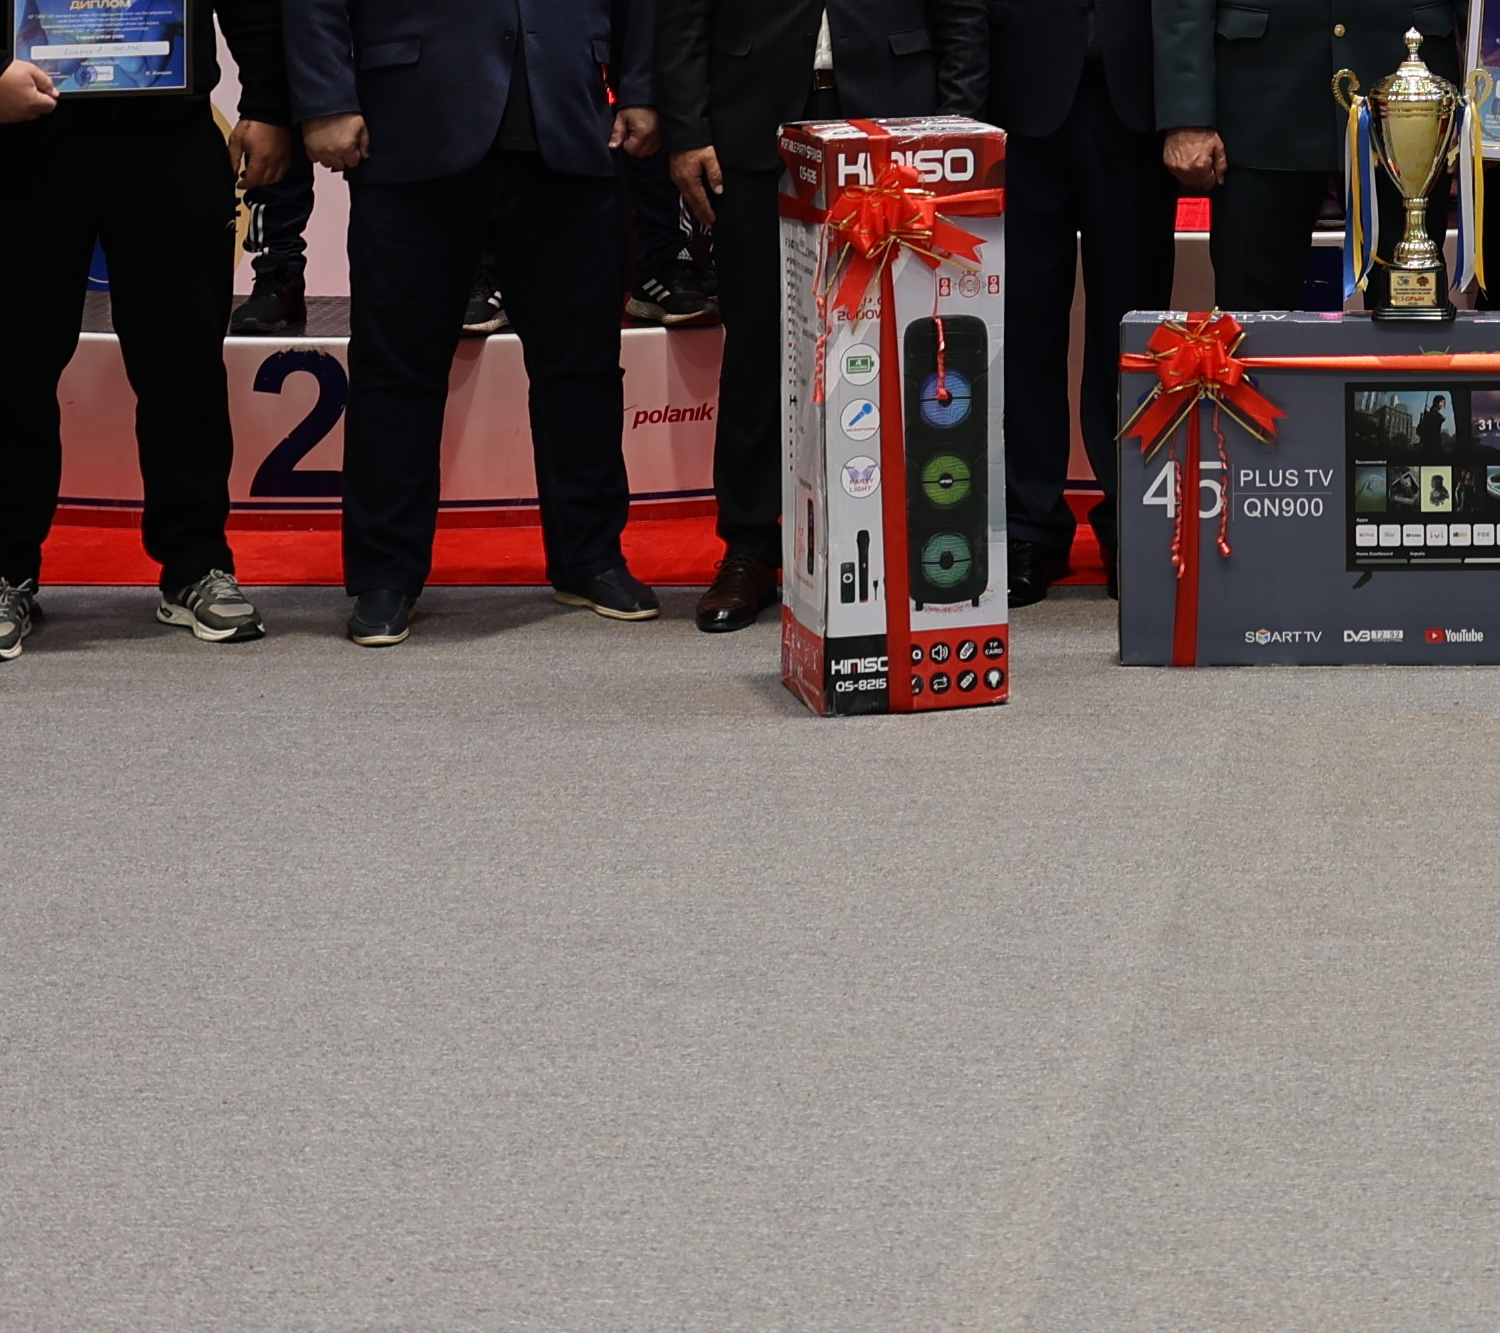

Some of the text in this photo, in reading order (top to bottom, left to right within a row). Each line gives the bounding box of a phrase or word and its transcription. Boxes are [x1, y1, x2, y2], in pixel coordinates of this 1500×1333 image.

[249, 349, 350, 498] 2
[632, 402, 716, 429] polanik
[849, 477, 875, 485] PARTY
[1240, 469, 1334, 488] PLUS TV
[849, 485, 873, 493] LIGHT
[1142, 460, 1225, 519] 45
[1243, 497, 1324, 518] QN900
[1303, 630, 1323, 644] TV
[1343, 629, 1371, 643] DVB
[1444, 628, 1485, 644] YouTube
[835, 678, 887, 693] QS-8215
